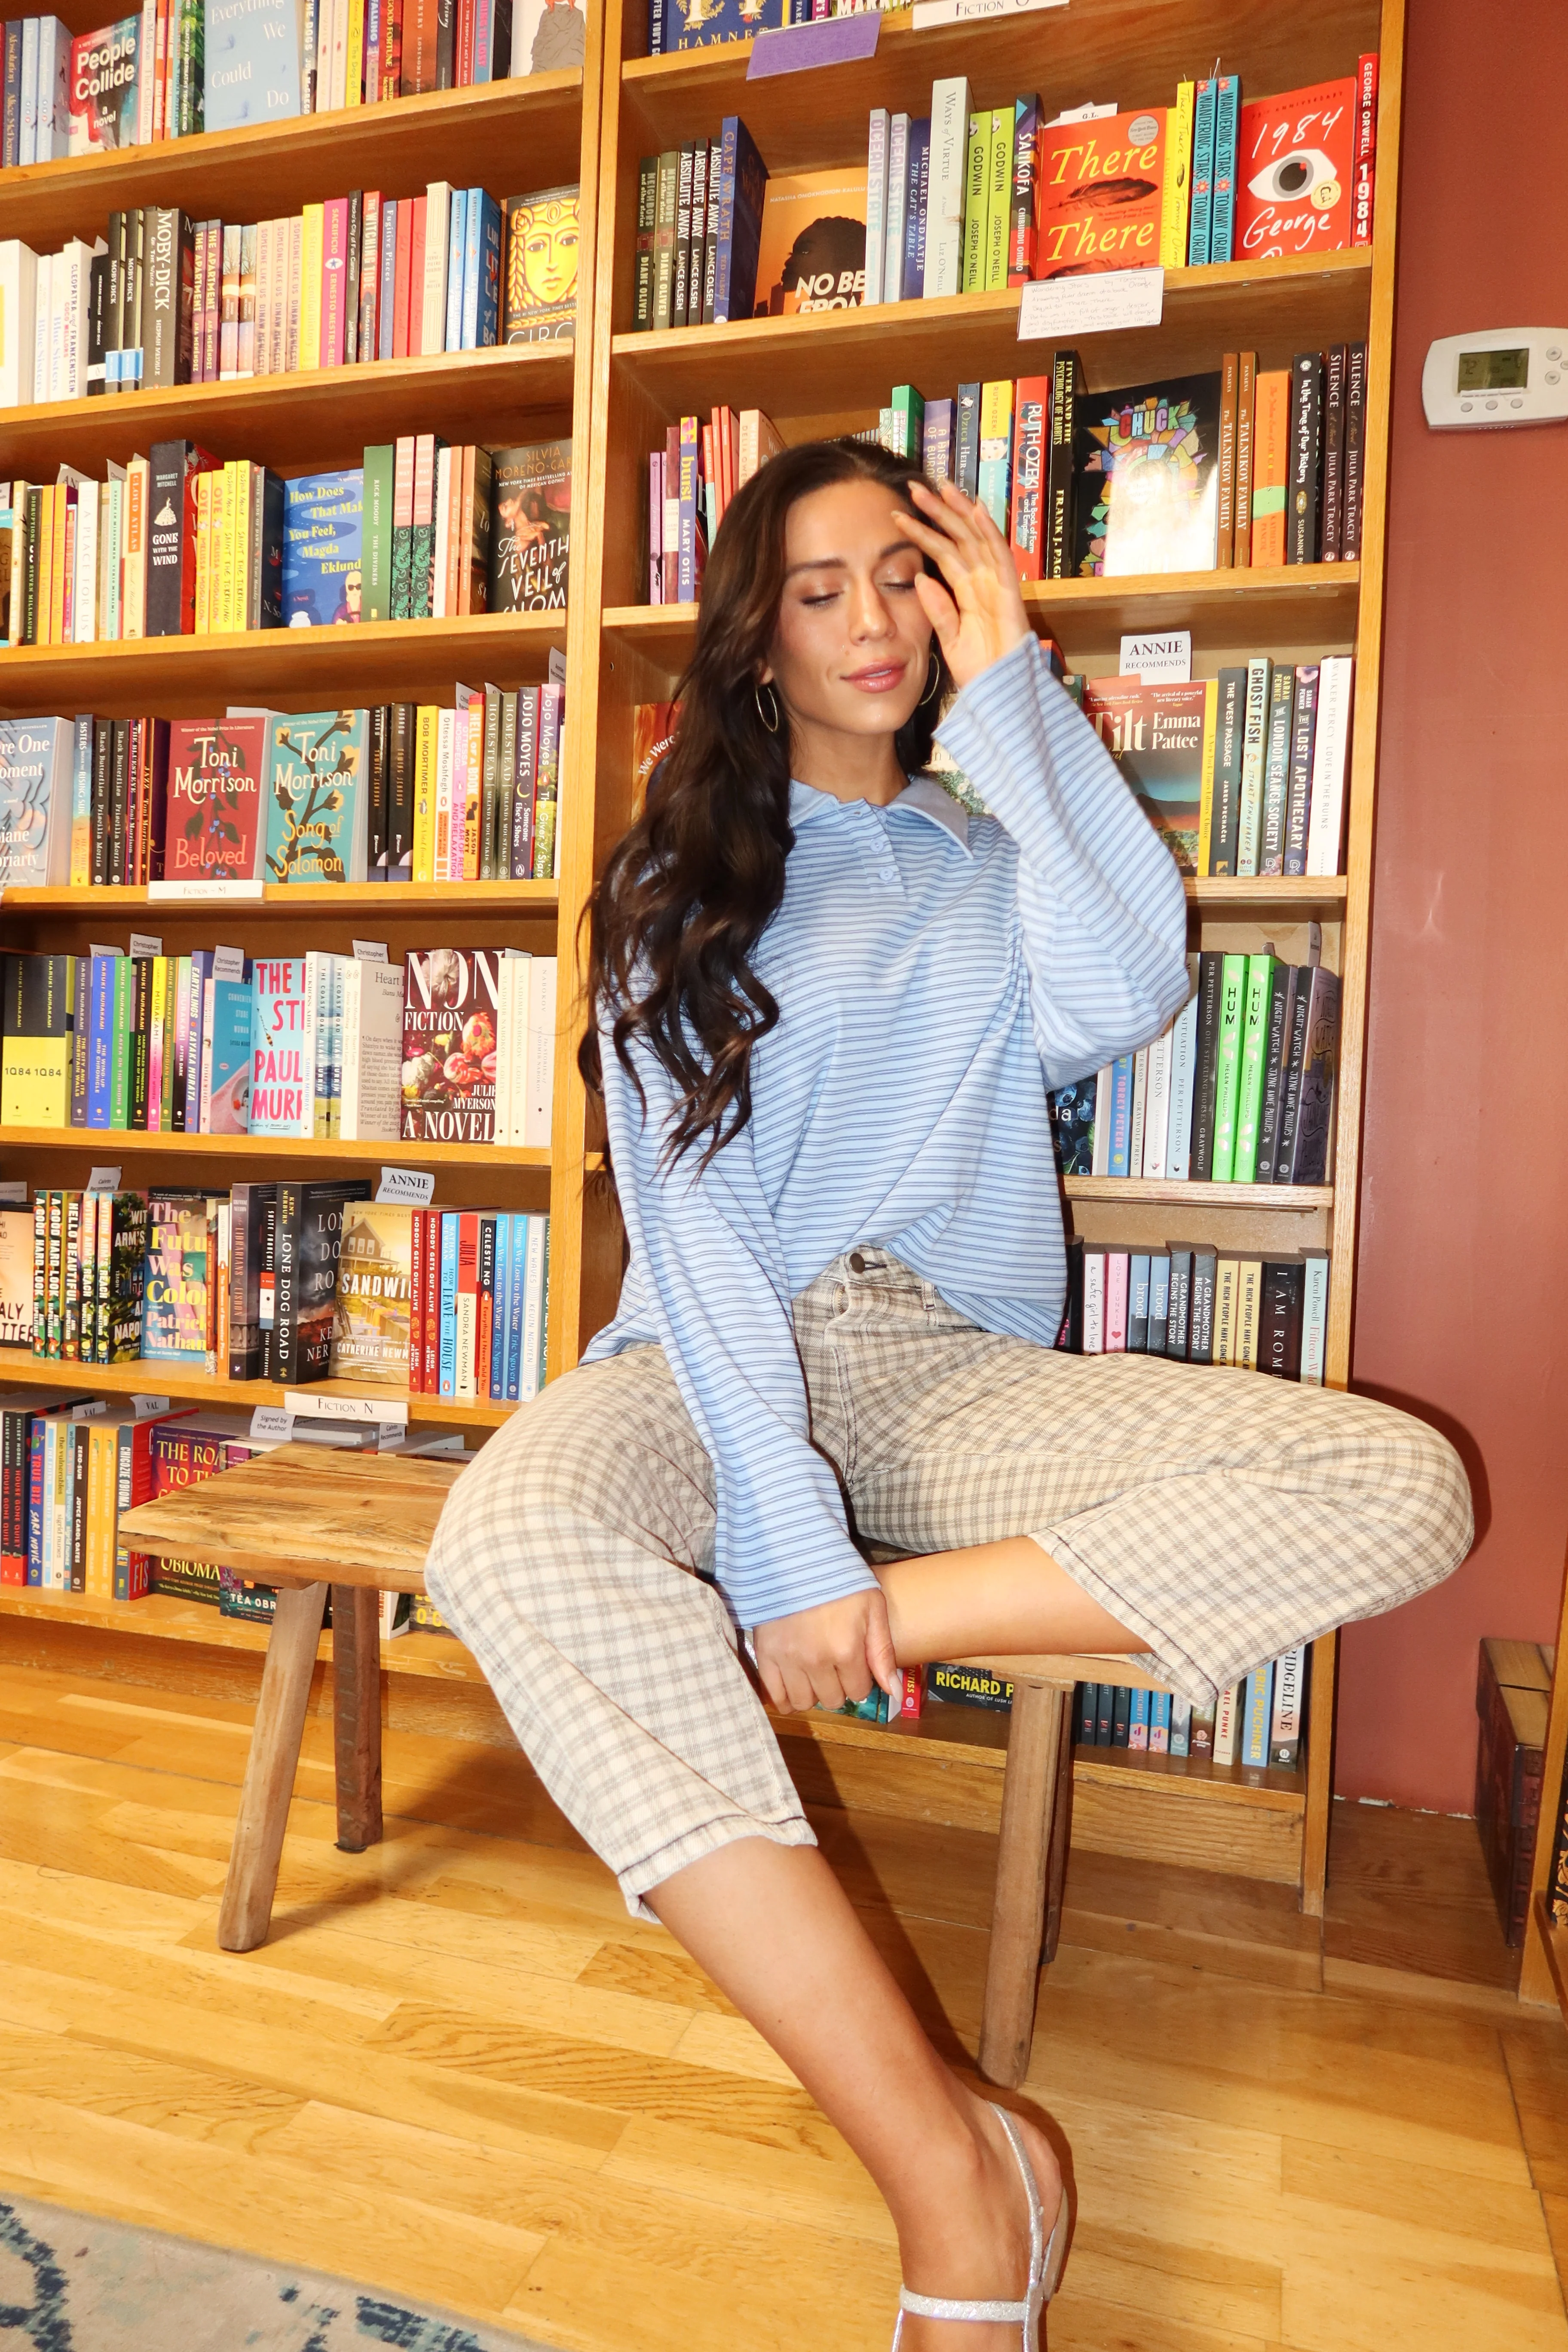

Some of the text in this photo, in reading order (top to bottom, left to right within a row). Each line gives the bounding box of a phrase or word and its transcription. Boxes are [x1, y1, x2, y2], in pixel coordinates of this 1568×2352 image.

[956, 0, 1004, 16] FICTION
[263, 22, 285, 40] We
[77, 37, 136, 73] People
[75, 64, 135, 100] Collide
[211, 61, 251, 89] Could
[267, 90, 289, 108] Do
[1360, 63, 1372, 156] GEORGE ORWELL
[94, 111, 116, 129] novel
[1217, 93, 1234, 178] WANDERING STARS
[1252, 107, 1343, 159] 1984
[973, 147, 983, 196] GODWIN
[1017, 133, 1032, 196] SANKOFA
[1049, 141, 1158, 185] There
[1214, 194, 1229, 233] TOMMY
[1356, 164, 1369, 237] 1984
[1046, 217, 1155, 261] There
[1243, 206, 1331, 251] George
[155, 213, 172, 310] MOBY-DICK
[969, 219, 979, 286] JOSEPH O'NEILL
[193, 232, 204, 312] THE APARTMENT
[795, 274, 834, 298] NO
[1350, 352, 1363, 407] SILENCE
[1120, 405, 1181, 437] CHUCK
[527, 446, 560, 462] SILVIA
[1024, 404, 1043, 489] RUTH OZEKI
[156, 472, 178, 481] MARGARET
[157, 479, 177, 487] MITCHELL
[681, 456, 695, 502] burst
[1220, 423, 1232, 530] TALNIKOV FAMILY
[290, 486, 344, 503] How Does
[1346, 450, 1358, 541] JULIA PARK TRACEY
[131, 516, 139, 551] ATLAS
[152, 532, 178, 545] GONE
[289, 527, 309, 540] You
[153, 555, 178, 566] WIND
[302, 545, 339, 560] Magda
[321, 560, 361, 575] Eklund
[497, 534, 569, 578] SEVENTH
[682, 519, 691, 585] MARY OTIS
[511, 561, 567, 600] VEIL of
[1125, 658, 1186, 669] RECOMMENDS
[1130, 640, 1182, 656] ANNIE
[1153, 712, 1200, 730] Emma
[1226, 702, 1234, 726] WEST
[1248, 668, 1264, 744] GHOST FISH
[520, 694, 533, 777] JOJO MOYES
[541, 693, 555, 766] Jojo Moyes
[1152, 732, 1198, 750] Pattee
[194, 736, 238, 768] Toni
[294, 732, 336, 763] Toni
[1223, 729, 1233, 767] PASSAGE
[275, 763, 353, 801] Morrison
[421, 741, 429, 794] MORTIMER
[173, 767, 257, 805] Morrison
[540, 791, 550, 809] The
[1266, 720, 1285, 851] LONDON SÉANCE SOCIETY
[1290, 728, 1309, 850] LOST APOTHECARY
[282, 810, 344, 848] Song of
[539, 811, 548, 839] Giver
[174, 835, 247, 868] Beloved
[275, 845, 343, 877] Solomon
[536, 854, 546, 878] Stars
[215, 966, 241, 974] Recommends
[216, 957, 241, 966] Christopher
[190, 967, 200, 1019] EARTHLINGS
[1250, 988, 1262, 1026] HUM
[405, 1011, 464, 1031] FICTION
[5, 1067, 31, 1076] 1Q84
[34, 1068, 61, 1077] 1Q84
[453, 1097, 496, 1110] MYERSON
[471, 1084, 496, 1096] JULIE
[403, 1110, 495, 1141] A NOVEL
[382, 1187, 429, 1200] RECOMMENDS
[389, 1174, 429, 1190] ANNIE
[34, 1211, 45, 1296] GOOD HARD LOOK
[66, 1203, 79, 1303] HELLO BEAUTIFUL
[483, 1272, 490, 1286] NG
[279, 1234, 292, 1360] LONE DOG ROAD
[1135, 1283, 1148, 1319] brood
[461, 1298, 469, 1337] SANDRA
[1200, 1287, 1210, 1351] GRANDMOTHER
[337, 1342, 380, 1357] CATHERINE
[260, 1415, 279, 1423] Signed
[317, 1397, 373, 1414] FICTION N
[268, 1424, 287, 1432] Author
[29, 1455, 42, 1504] TRUE BIZ
[936, 1671, 1001, 1695] RICHARD
[1254, 1669, 1266, 1696] ERIC
[1221, 1711, 1230, 1739] PUNKE
[1250, 1699, 1265, 1760] PUCHNER
